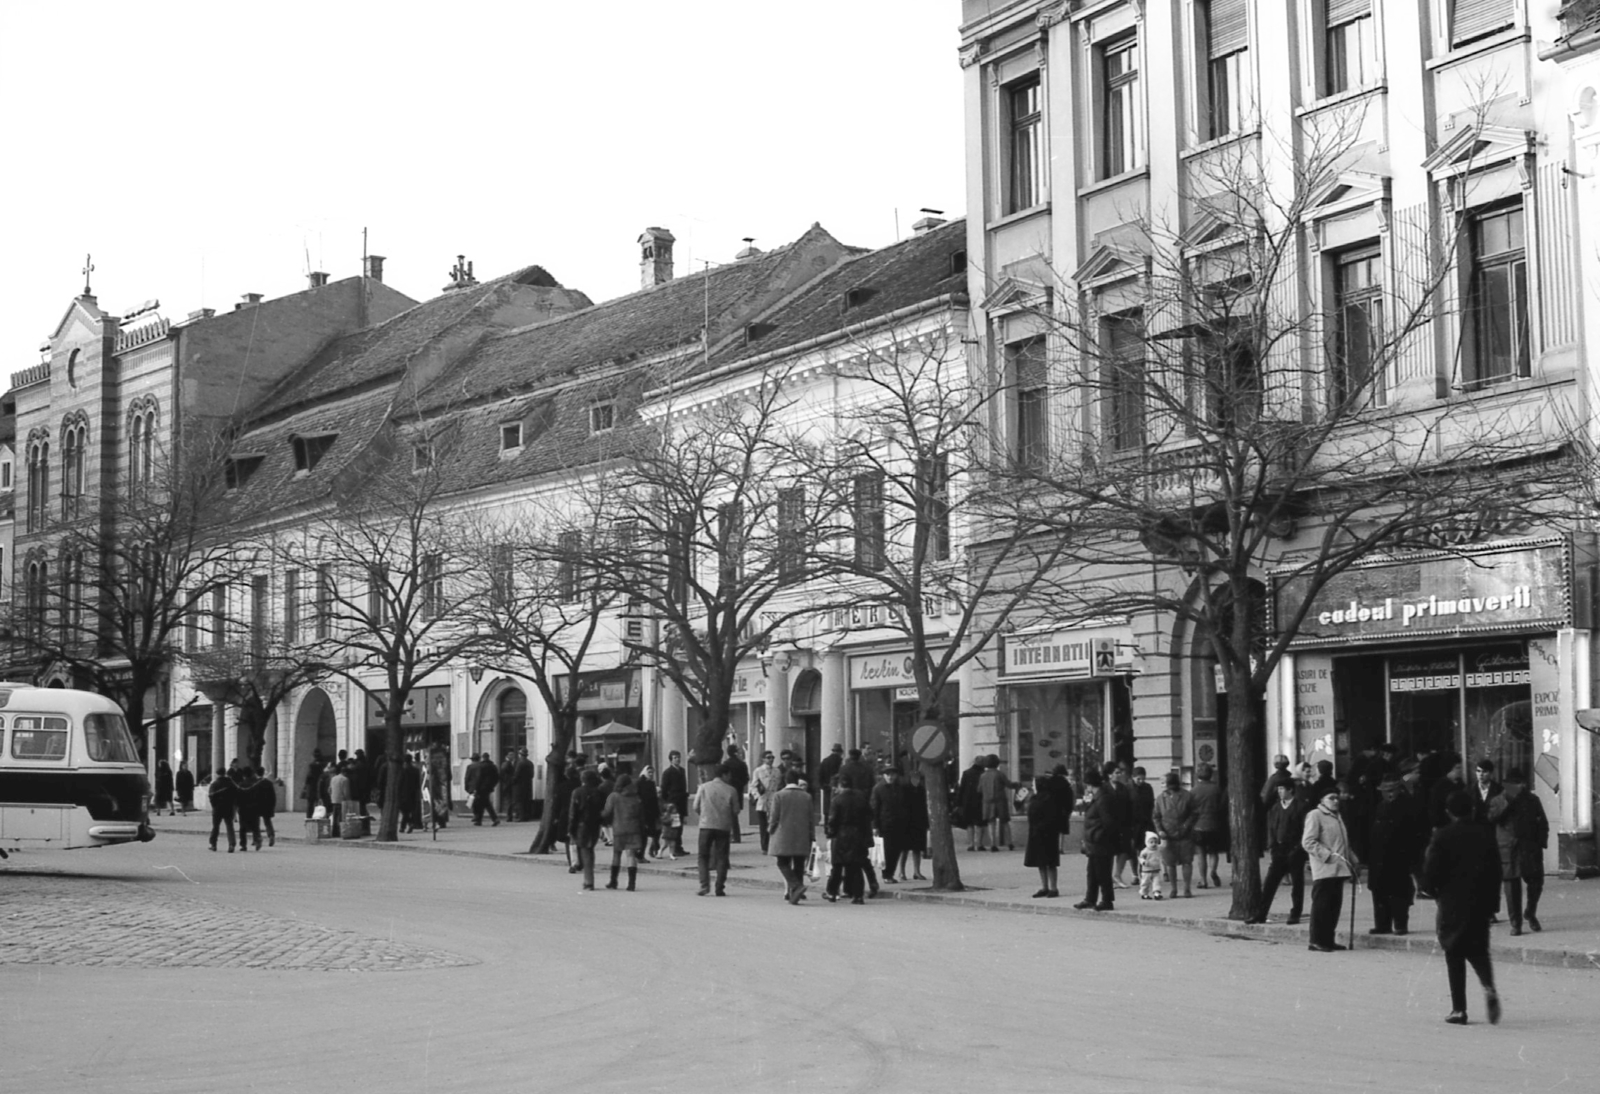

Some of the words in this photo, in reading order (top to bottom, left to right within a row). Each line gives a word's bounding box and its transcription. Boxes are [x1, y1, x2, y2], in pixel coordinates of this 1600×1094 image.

[1318, 598, 1392, 625] cadoul
[1402, 585, 1531, 627] primaverii
[1318, 669, 1328, 680] DE
